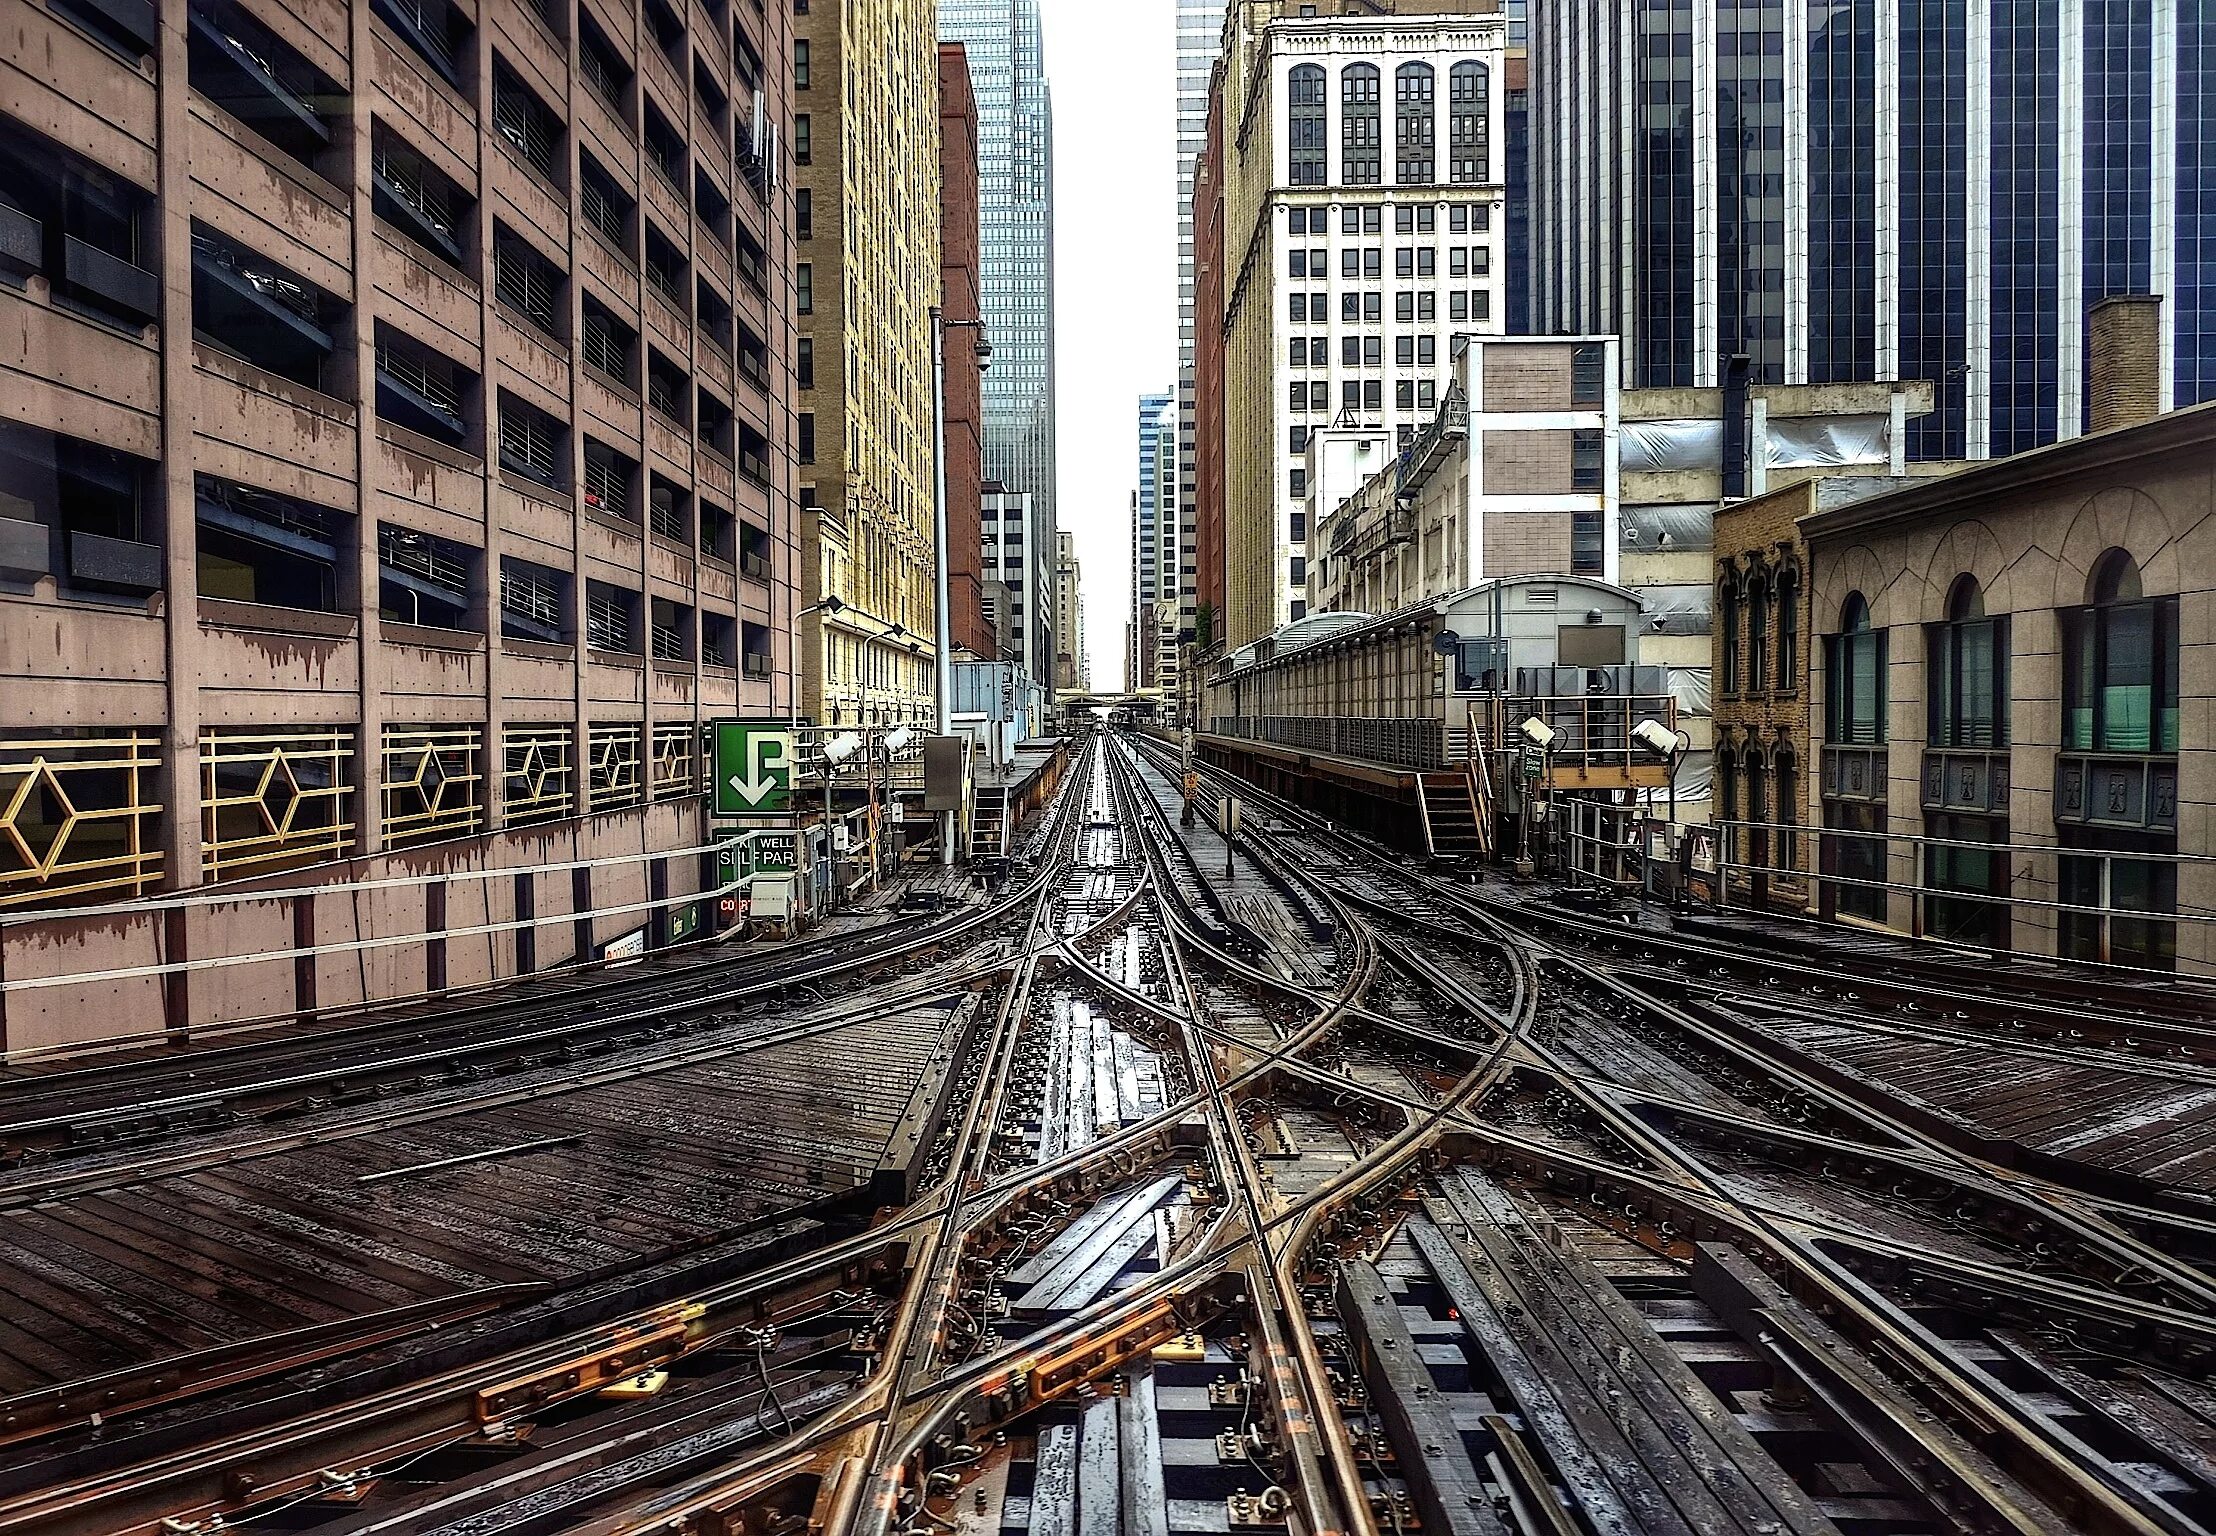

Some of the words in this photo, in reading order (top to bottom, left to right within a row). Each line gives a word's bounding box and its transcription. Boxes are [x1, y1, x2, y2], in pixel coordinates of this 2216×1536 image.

[1186, 787, 1197, 795] 35
[759, 837, 795, 848] WELL
[763, 851, 793, 865] PAR
